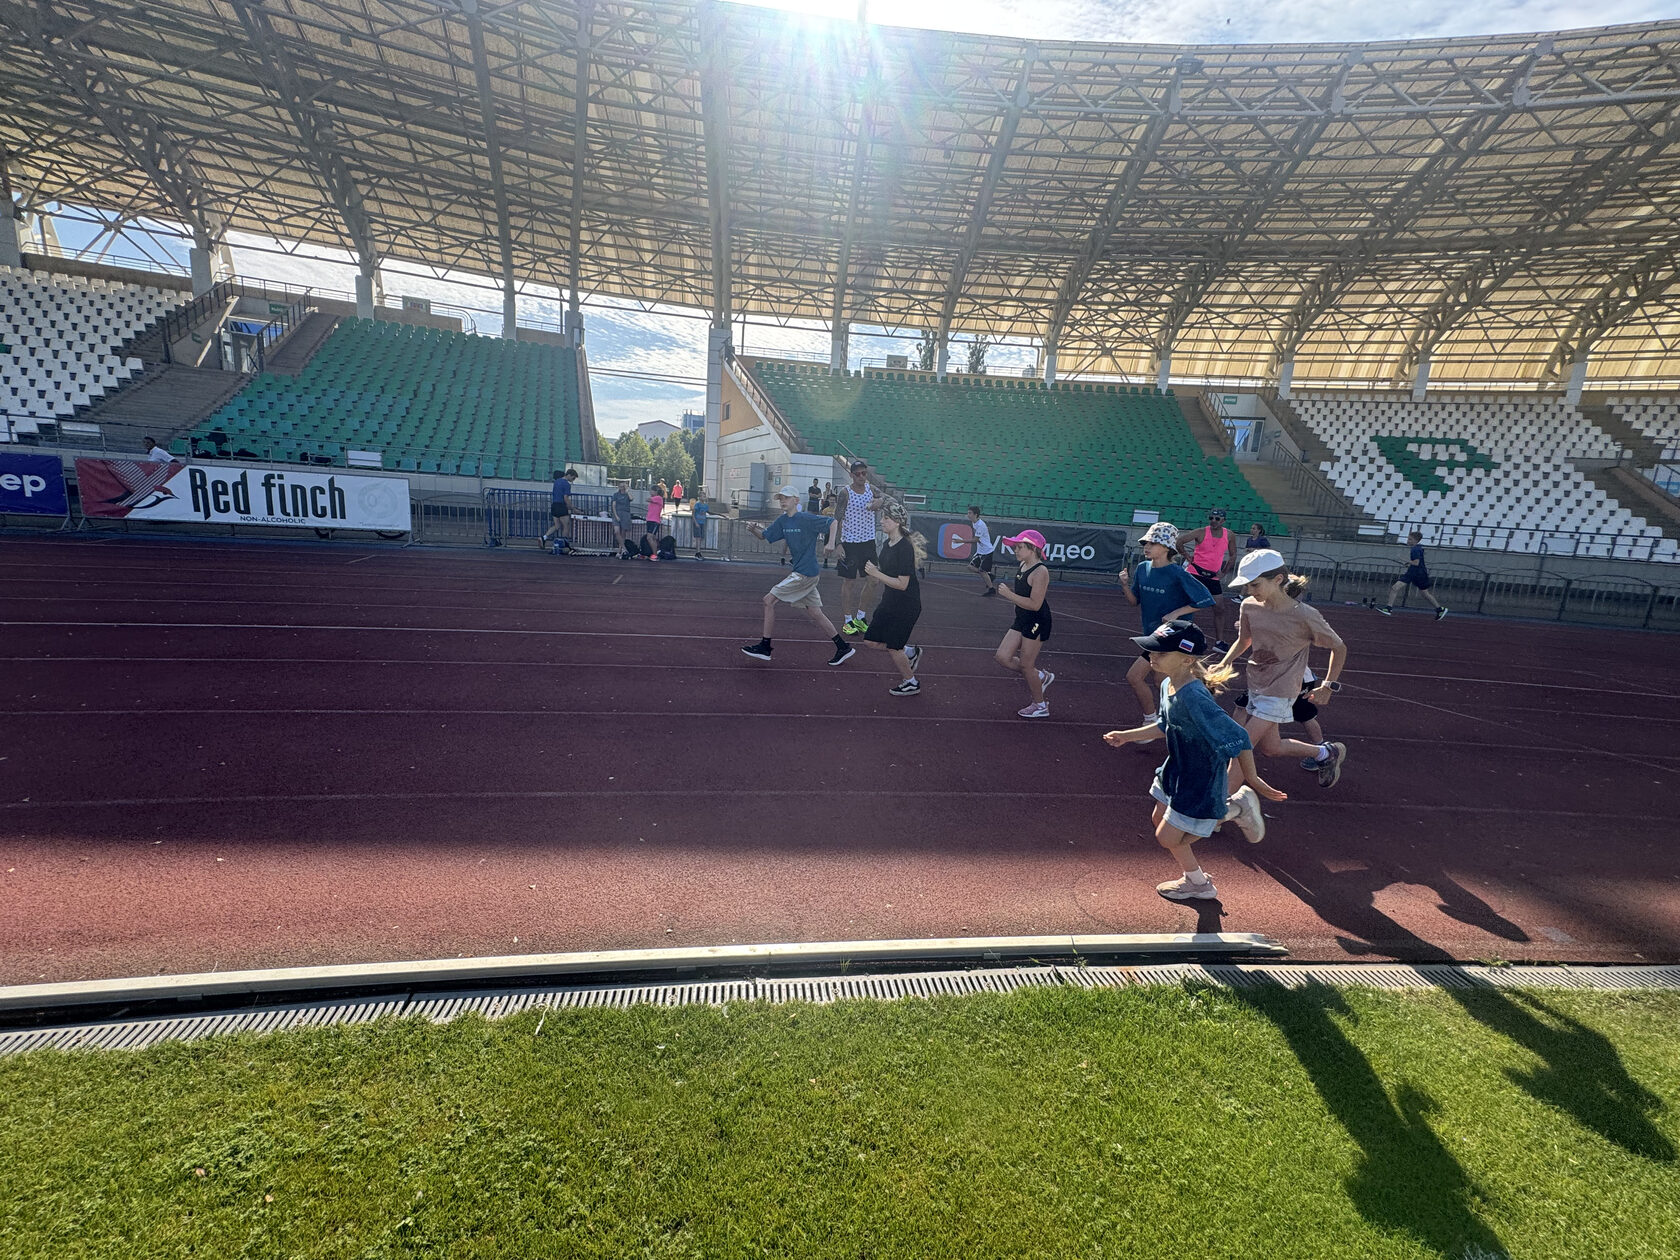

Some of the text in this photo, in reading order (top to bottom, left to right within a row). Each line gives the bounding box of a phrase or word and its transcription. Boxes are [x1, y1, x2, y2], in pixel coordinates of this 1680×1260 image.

[189, 468, 251, 520] Red
[261, 474, 346, 519] finch
[240, 516, 306, 524] NON-ALCOHOLIC
[1040, 543, 1096, 561] идео
